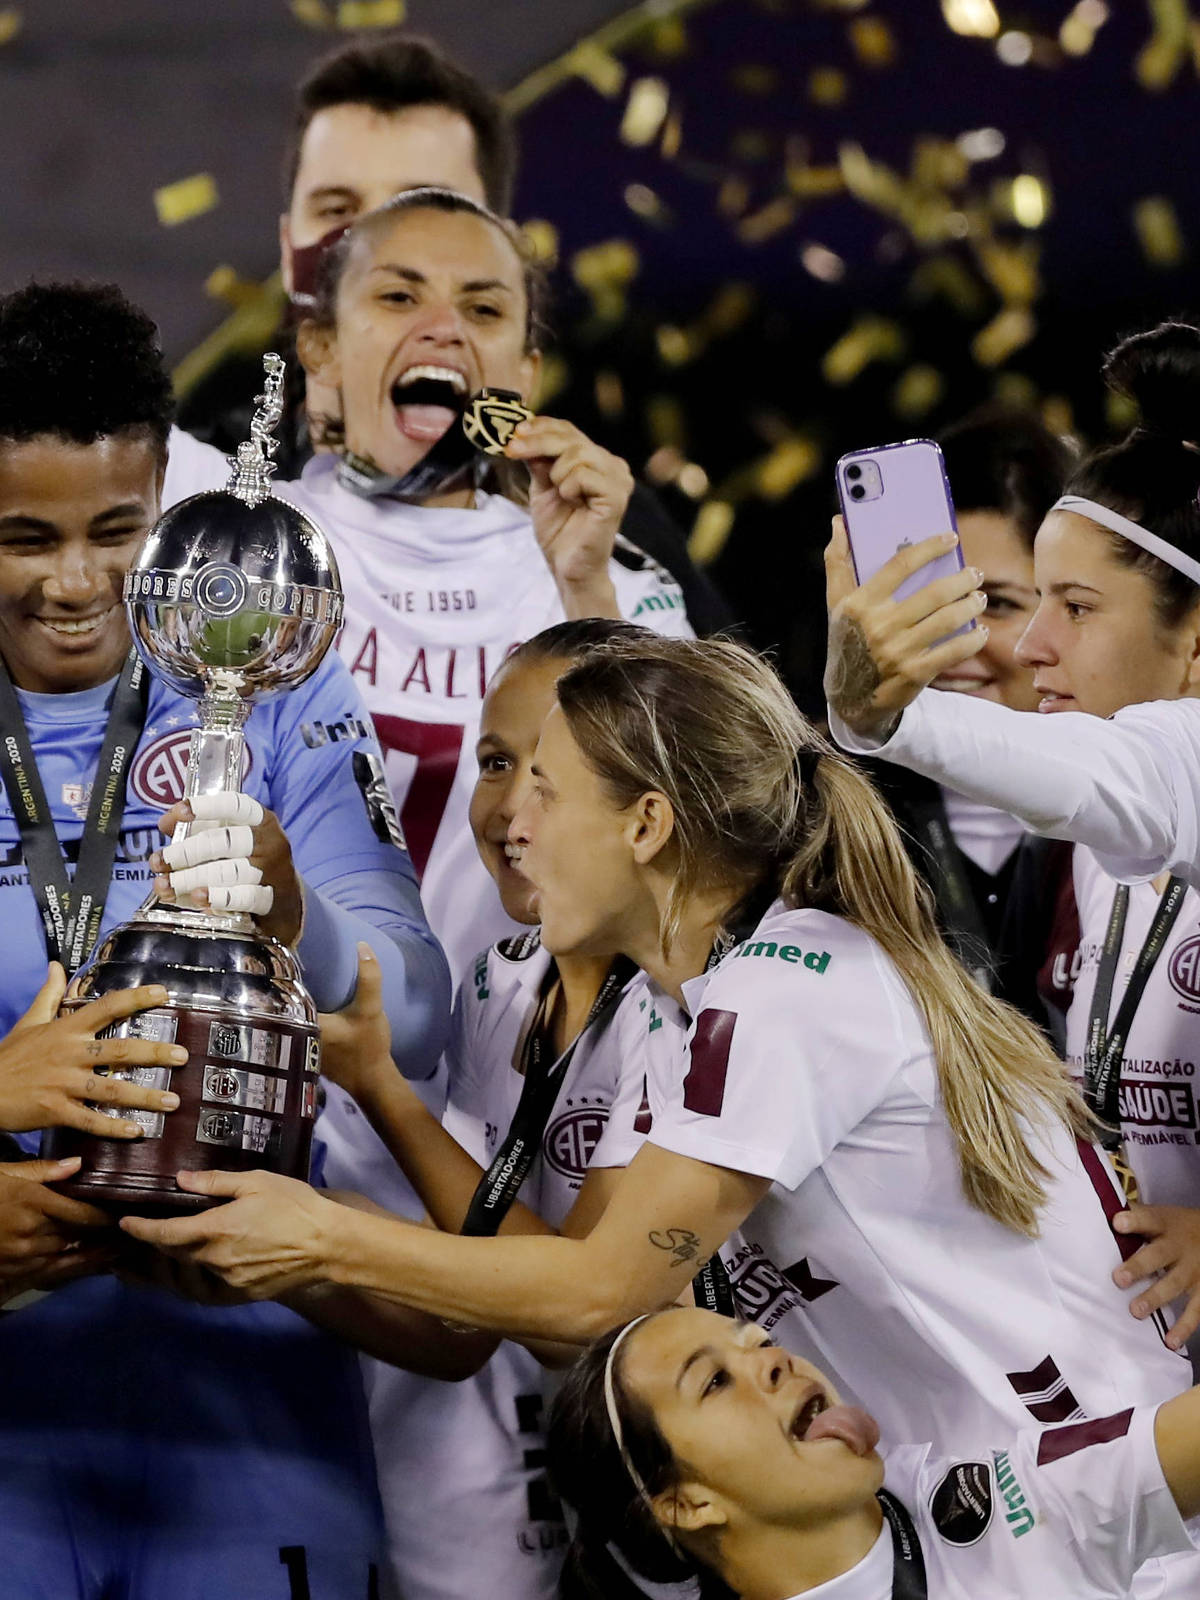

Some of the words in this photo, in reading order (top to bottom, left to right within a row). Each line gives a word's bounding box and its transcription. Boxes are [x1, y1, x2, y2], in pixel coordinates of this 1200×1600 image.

[257, 587, 314, 614] COPA
[427, 588, 476, 612] 1950
[4, 735, 22, 765] 2020
[13, 766, 40, 825] ARGENTINA
[97, 775, 119, 835] ARGENTINA
[110, 745, 126, 774] 2020
[1164, 885, 1181, 912] 2020
[69, 894, 92, 973] LIBERTADORES
[1095, 1033, 1121, 1110] LIBERTADORES
[484, 1139, 524, 1209] LIBERTADORES
